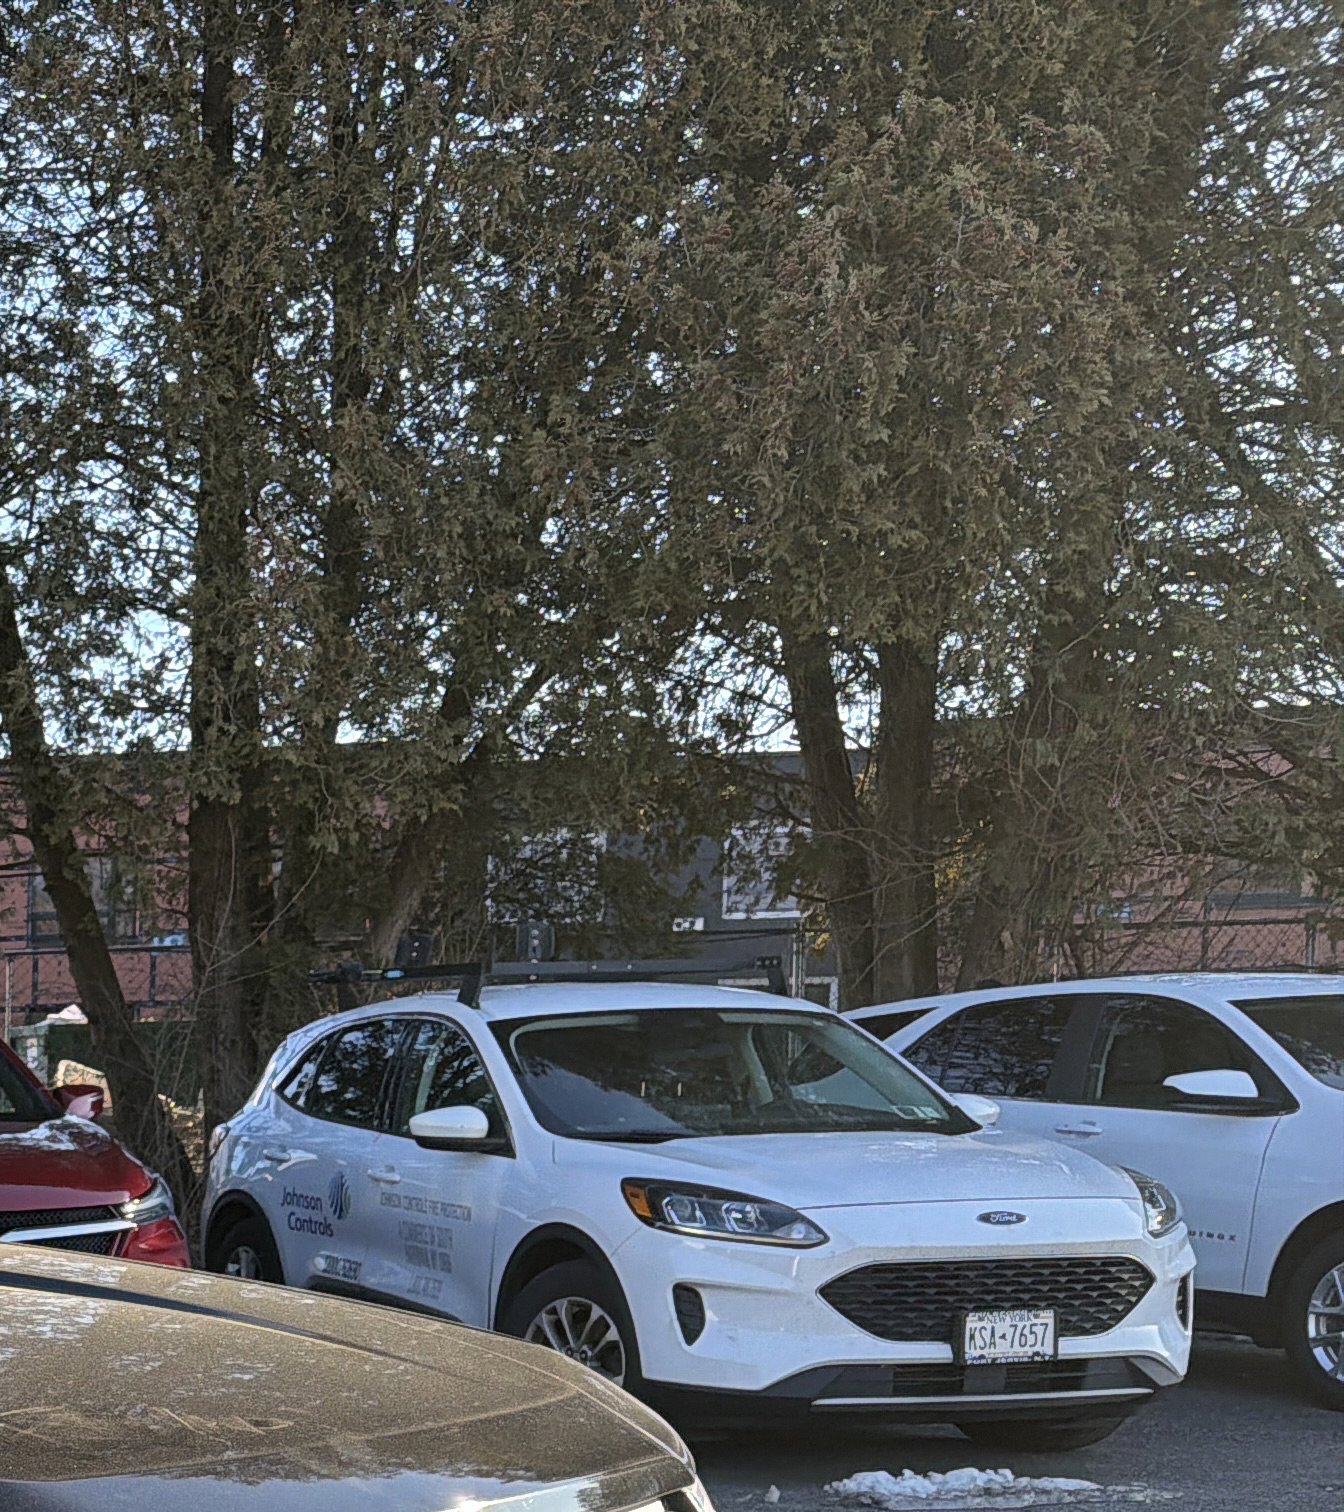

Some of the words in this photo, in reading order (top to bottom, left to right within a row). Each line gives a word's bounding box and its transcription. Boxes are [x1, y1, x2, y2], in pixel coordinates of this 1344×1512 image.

[280, 1186, 323, 1211] Johnson
[288, 1213, 334, 1238] Controls
[1188, 1230, 1236, 1242] UINOX
